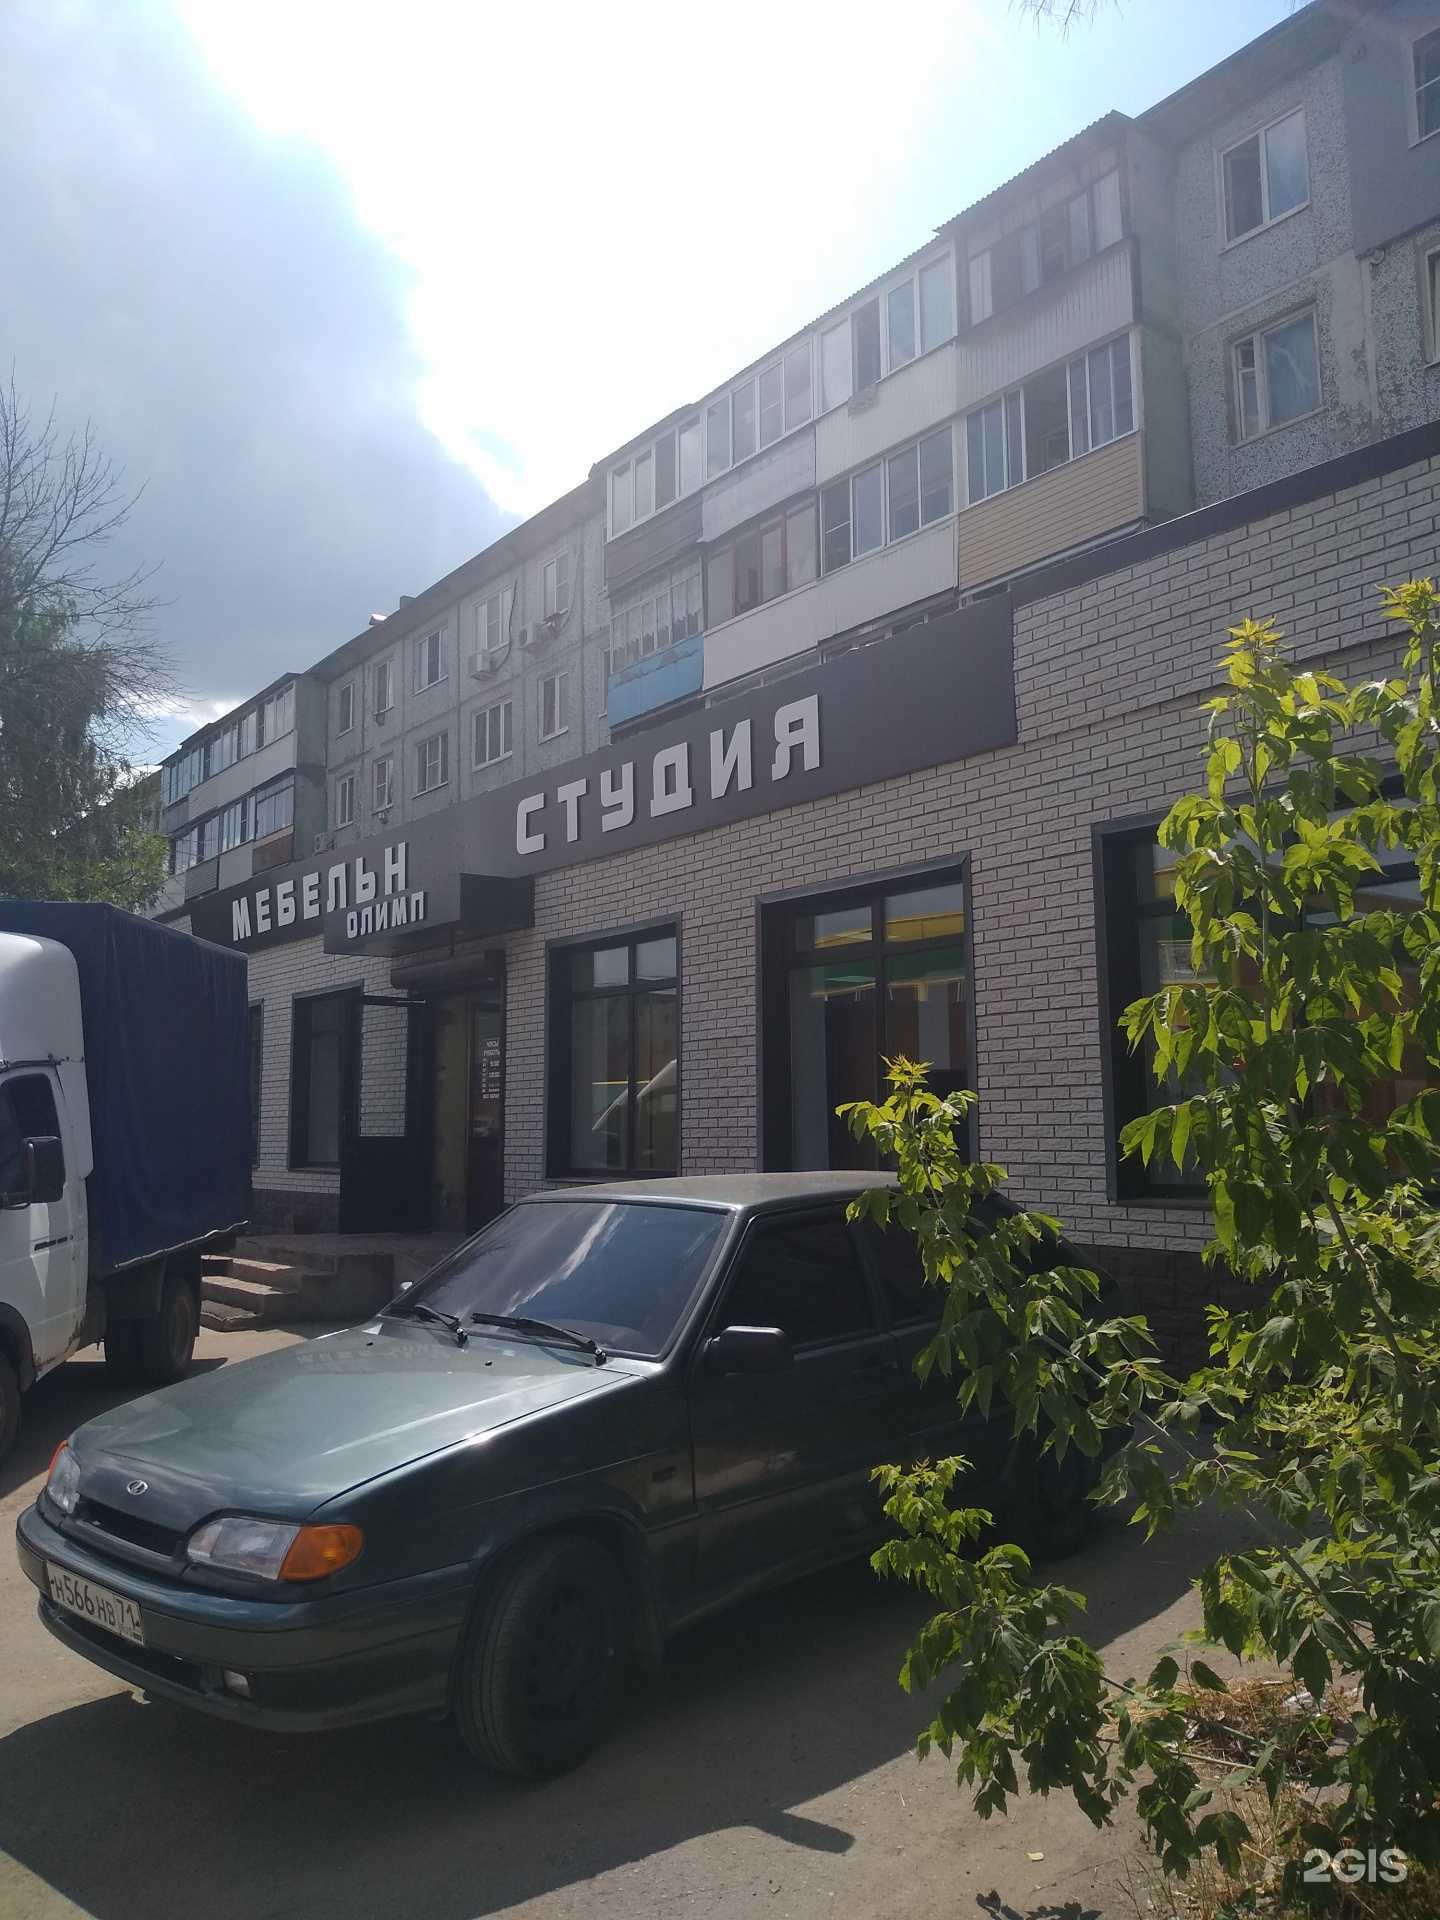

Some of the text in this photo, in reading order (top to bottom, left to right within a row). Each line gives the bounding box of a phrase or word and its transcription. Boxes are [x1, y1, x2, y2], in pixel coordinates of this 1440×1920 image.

[232, 694, 820, 942] МЕБЕЛЬН СТУДИЯ
[346, 890, 425, 939] ОЛИМП
